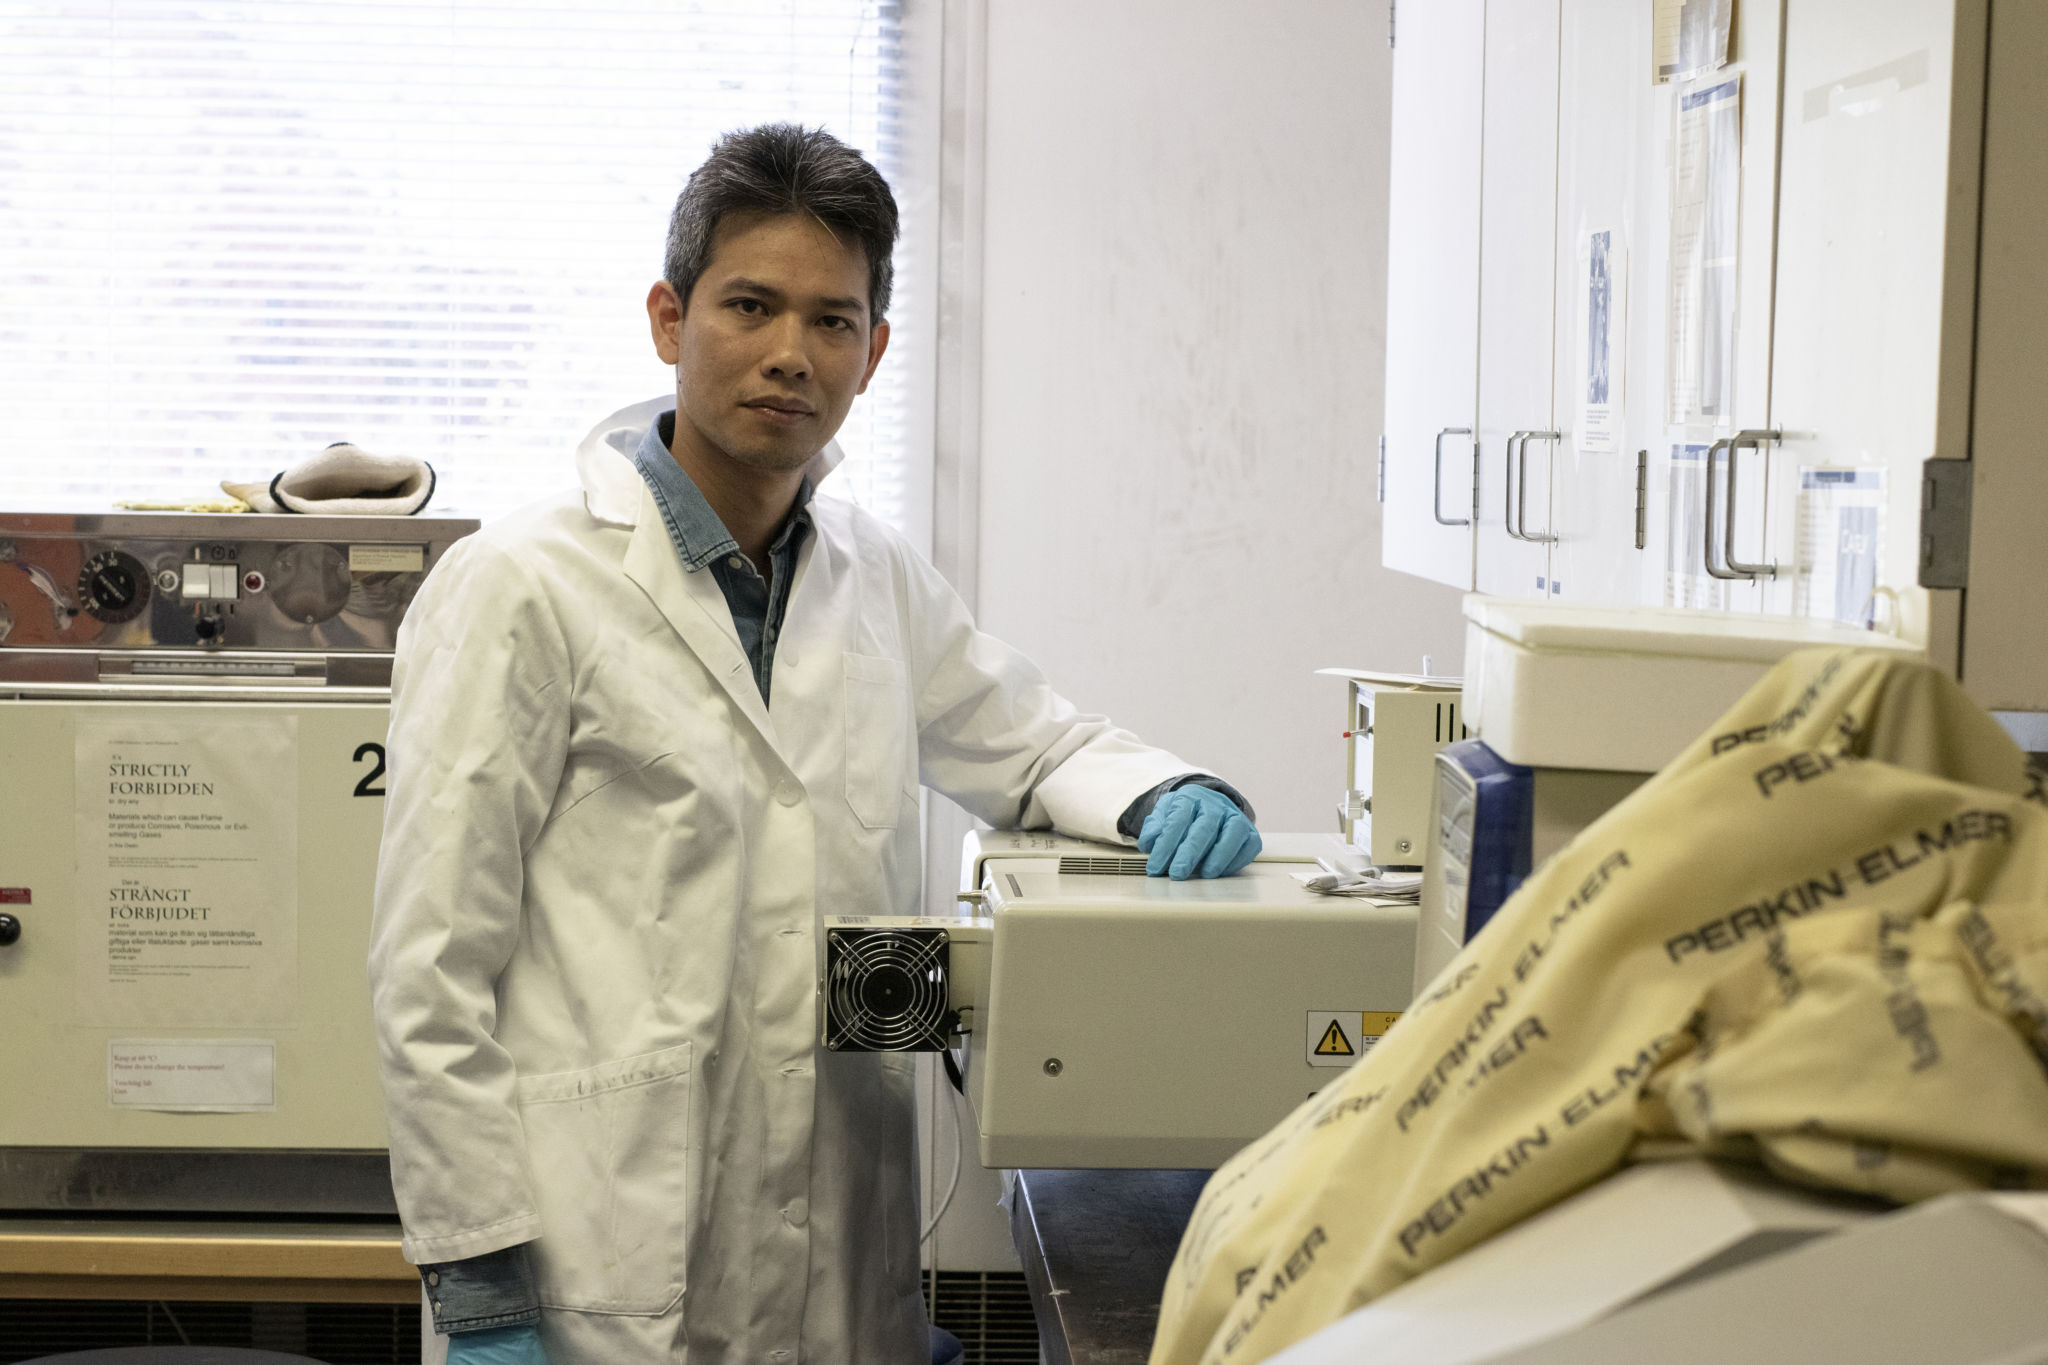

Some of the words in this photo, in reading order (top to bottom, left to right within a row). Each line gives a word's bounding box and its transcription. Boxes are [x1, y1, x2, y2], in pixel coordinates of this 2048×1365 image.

[109, 763, 191, 777] STRICTLY
[352, 742, 386, 797] 2
[109, 782, 214, 795] FORBIDDEN
[109, 886, 191, 901] STRÄNGT
[110, 904, 211, 922] FÖRBJUDET
[108, 946, 142, 954] produkter
